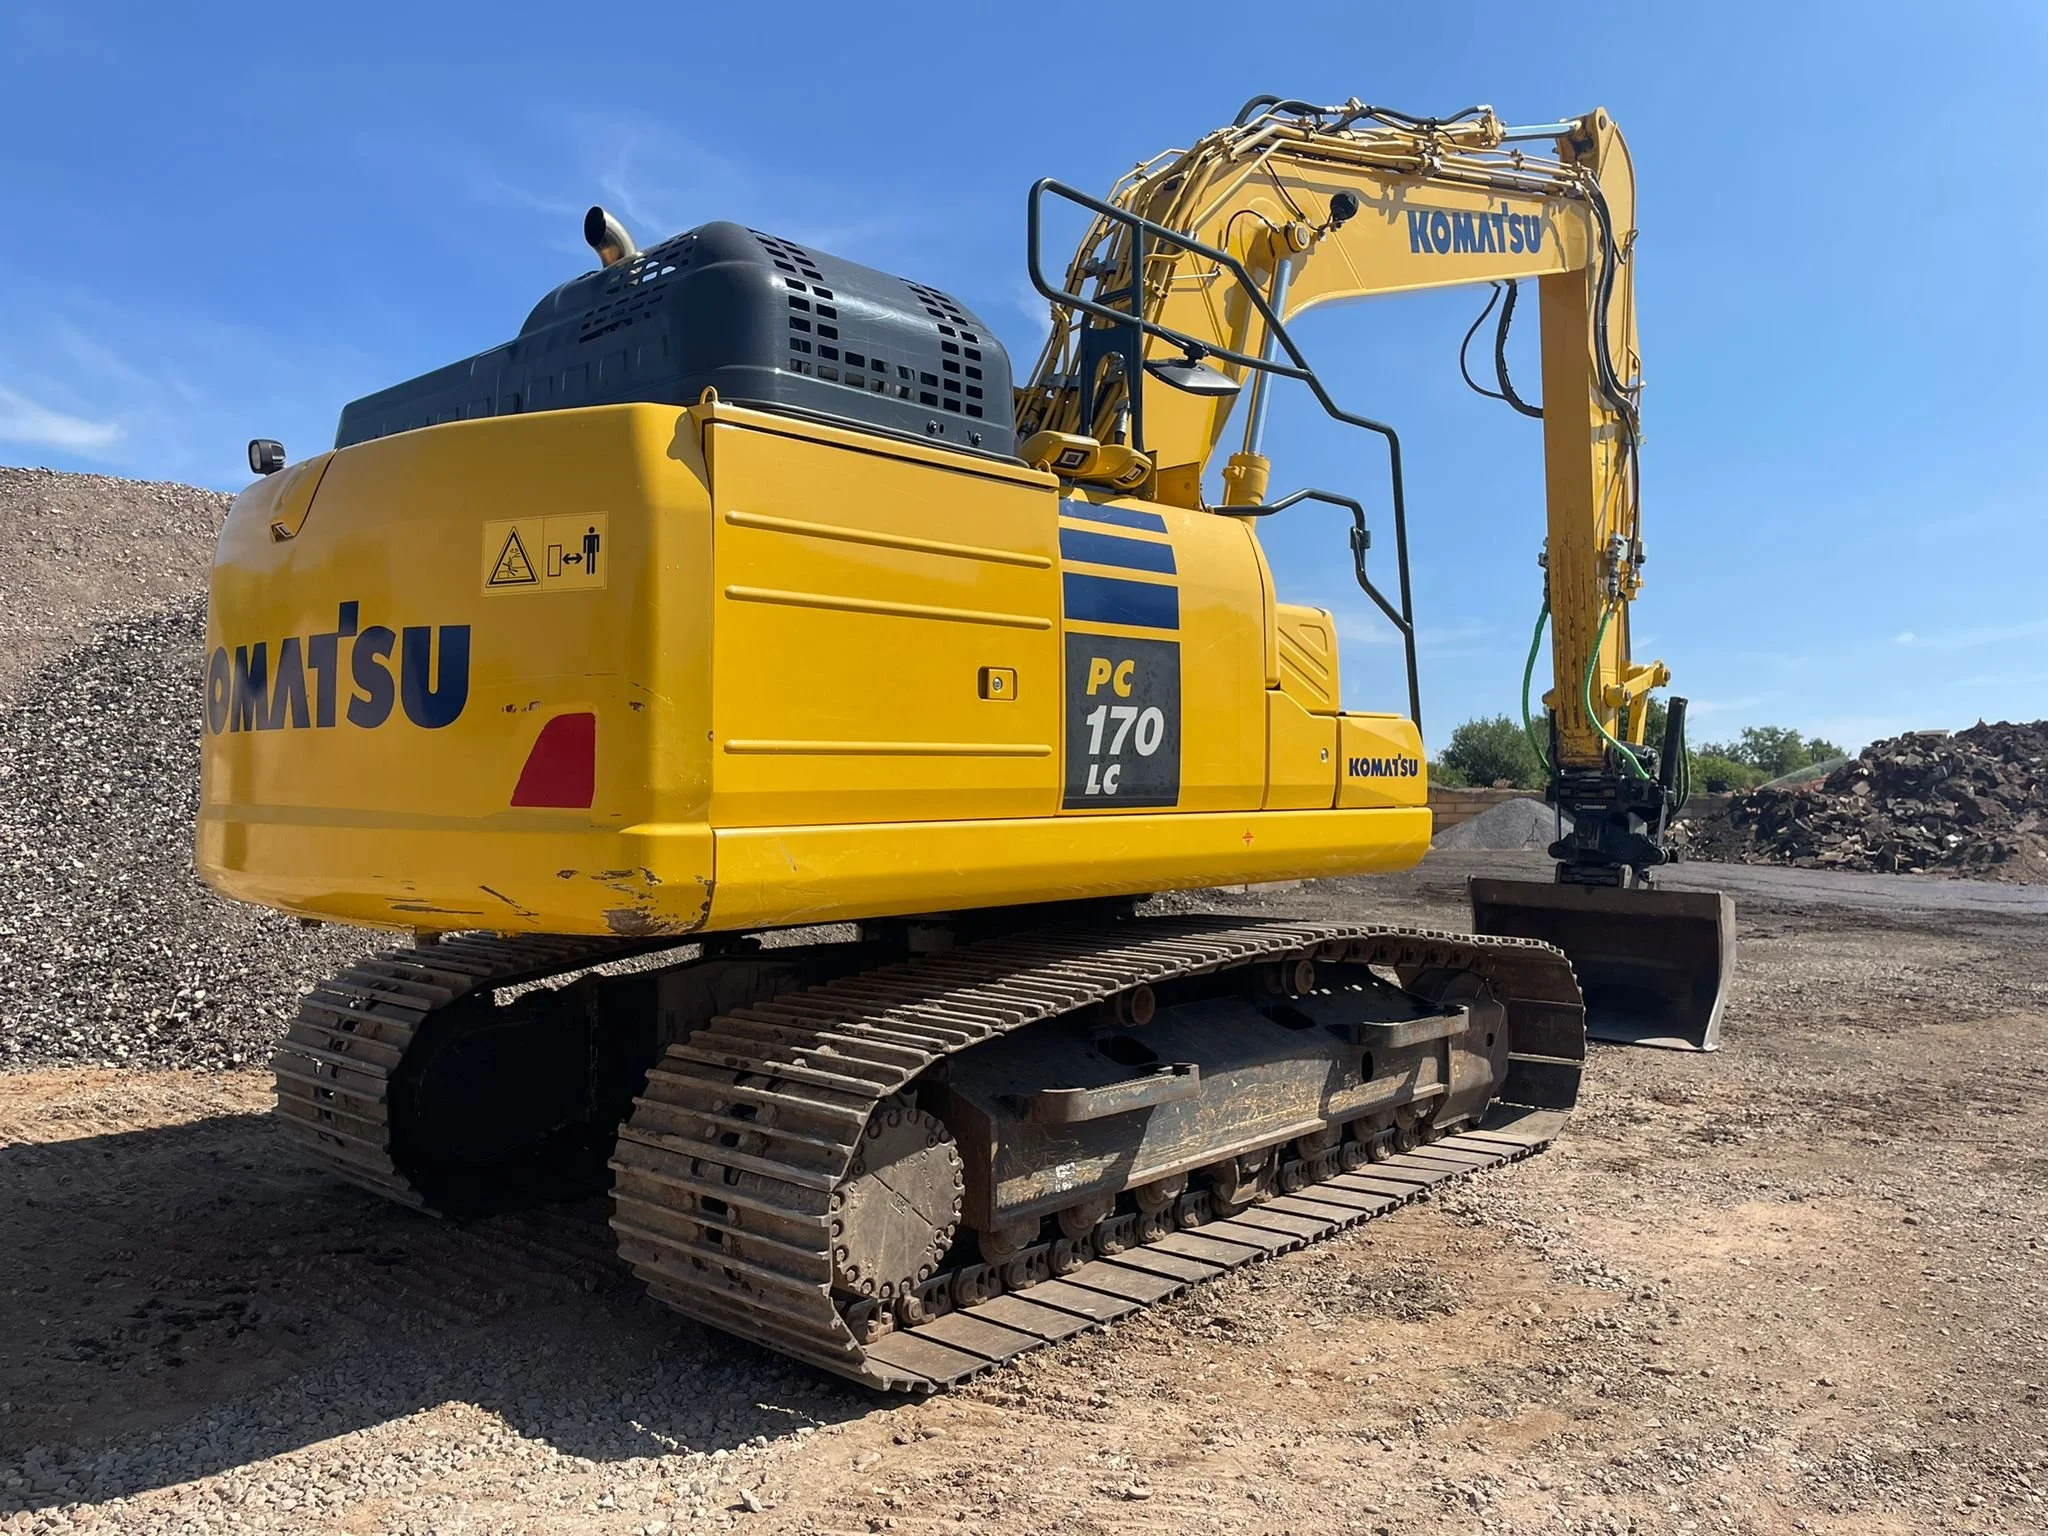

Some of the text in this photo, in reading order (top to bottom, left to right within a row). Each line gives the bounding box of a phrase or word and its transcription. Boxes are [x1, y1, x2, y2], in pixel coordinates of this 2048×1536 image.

[1407, 202, 1542, 254] KOMATSU
[203, 600, 471, 736] OMATSU
[1086, 657, 1136, 698] PC
[1086, 705, 1165, 757] 170
[1084, 763, 1122, 796] LC
[1348, 753, 1418, 777] KOMATSU
